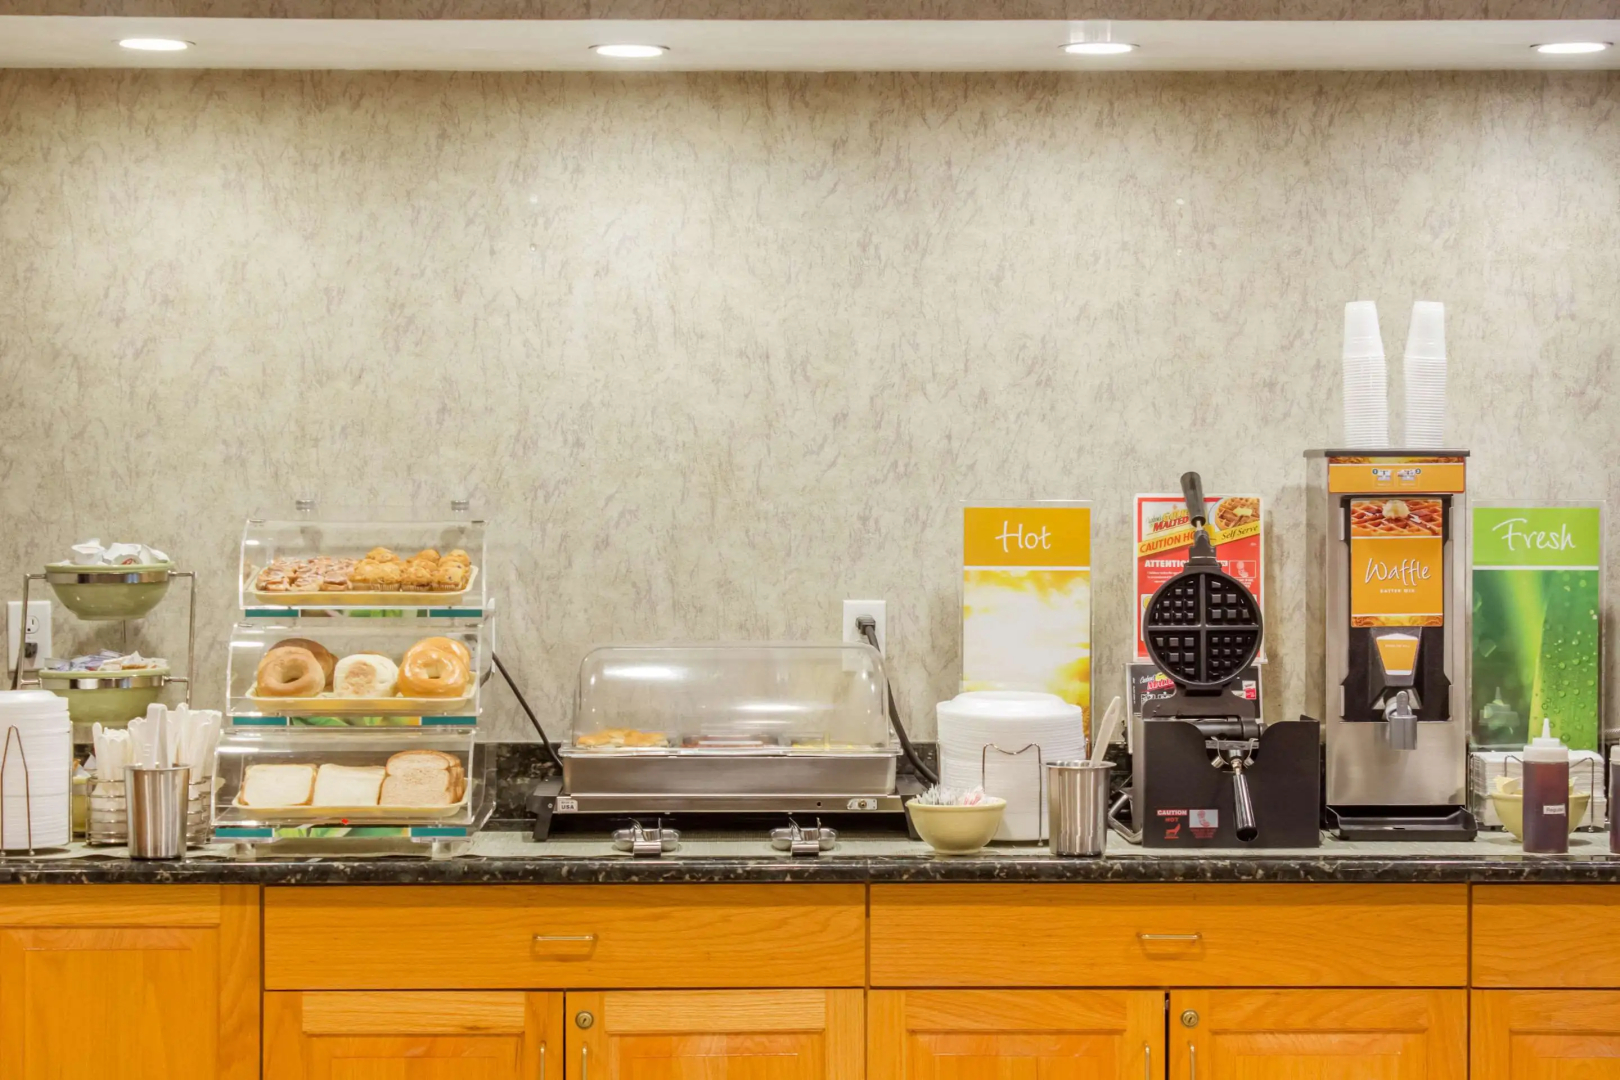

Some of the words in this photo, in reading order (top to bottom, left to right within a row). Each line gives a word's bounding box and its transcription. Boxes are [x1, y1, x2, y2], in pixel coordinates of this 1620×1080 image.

[995, 520, 1051, 553] Hot
[1139, 534, 1181, 553] CAUTION
[1182, 530, 1195, 542] HO
[1221, 529, 1237, 541] Self
[1237, 525, 1259, 537] Serve
[1492, 518, 1576, 551] Fresh
[1365, 558, 1431, 586] Waffle
